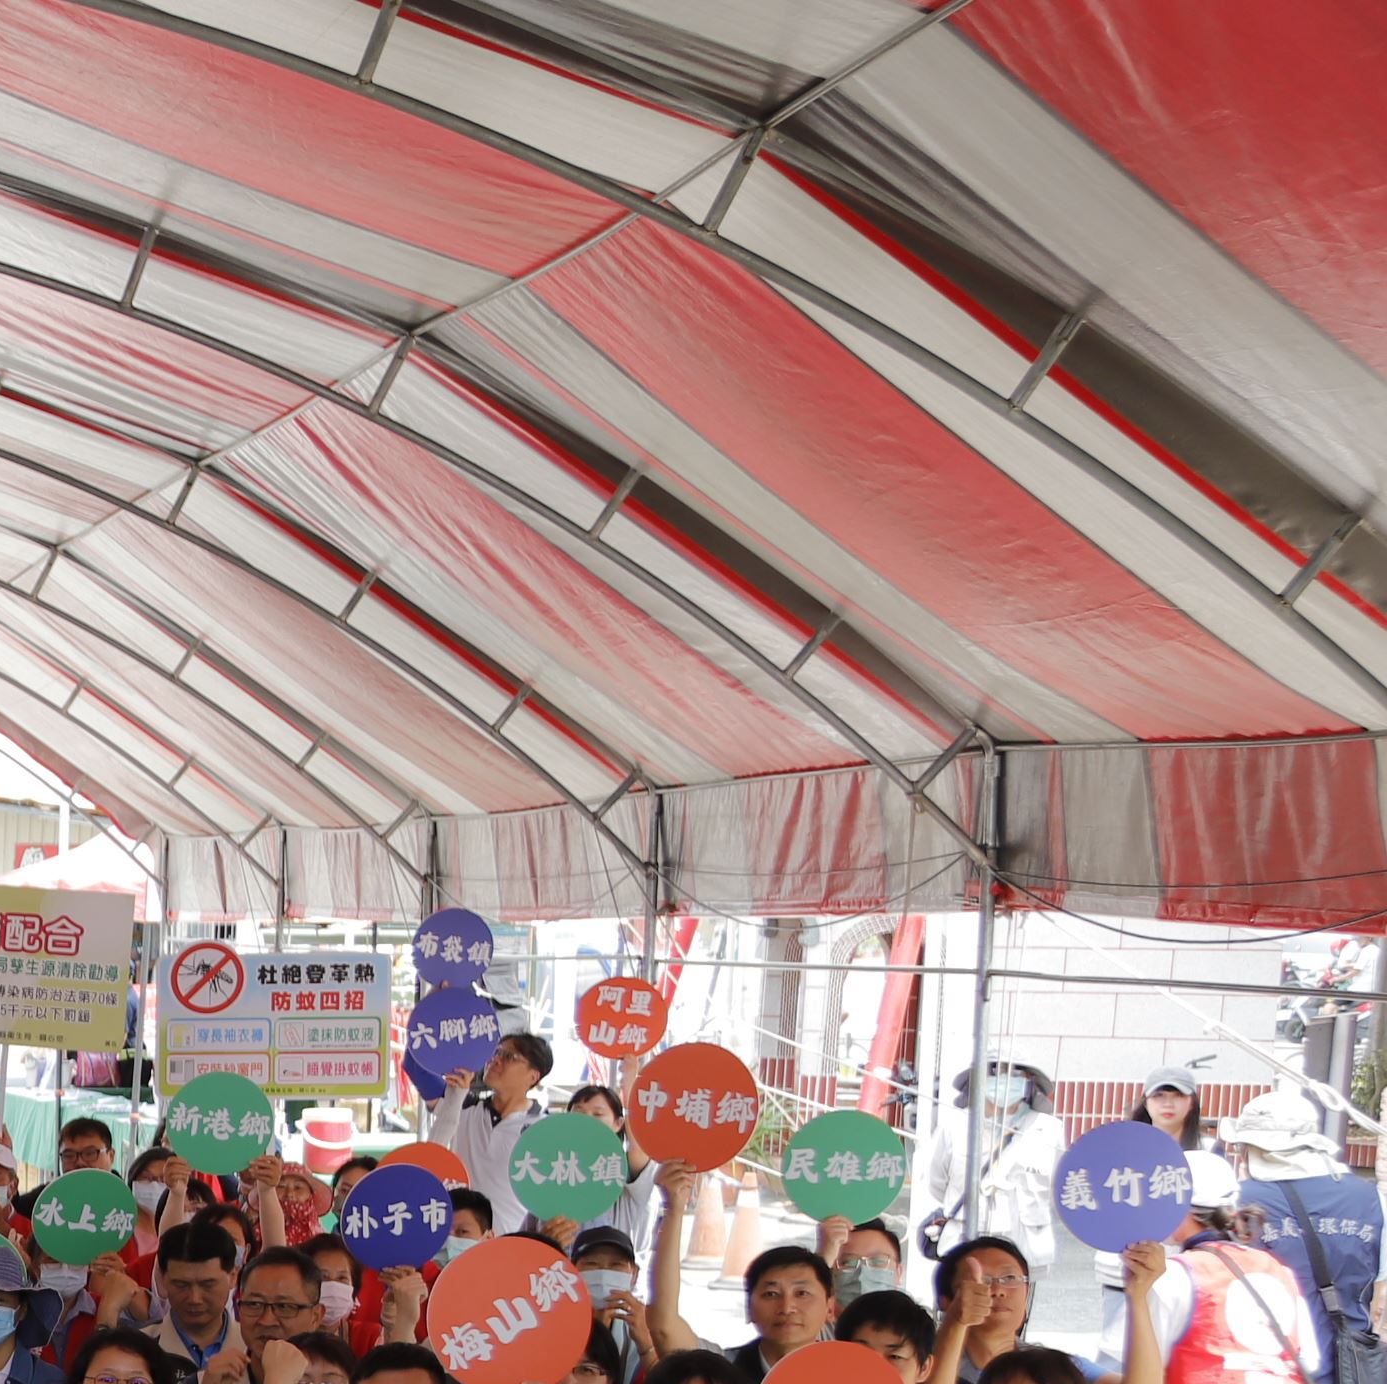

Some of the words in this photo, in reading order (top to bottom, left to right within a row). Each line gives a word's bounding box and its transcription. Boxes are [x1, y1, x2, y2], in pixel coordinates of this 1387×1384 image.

[415, 930, 492, 967] 布袋鎮
[257, 963, 376, 985] 杜絕登革熱
[271, 990, 365, 1012] 防蚊四招
[595, 983, 652, 1018] 阿里
[409, 1013, 498, 1050] 六腳鄉
[587, 1021, 648, 1051] 山鄉
[168, 1101, 272, 1144] 新港鄉
[637, 1080, 757, 1134] 中埔鄉
[511, 1150, 628, 1188] 大林鎮
[784, 1146, 904, 1188] 民雄鄉
[1059, 1164, 1193, 1211] 義竹鄉
[33, 1195, 134, 1240] 水上鄉
[343, 1198, 449, 1240] 朴子市
[1260, 1216, 1374, 1243] 嘉義環保局
[440, 1259, 580, 1371] 梅山鄉
